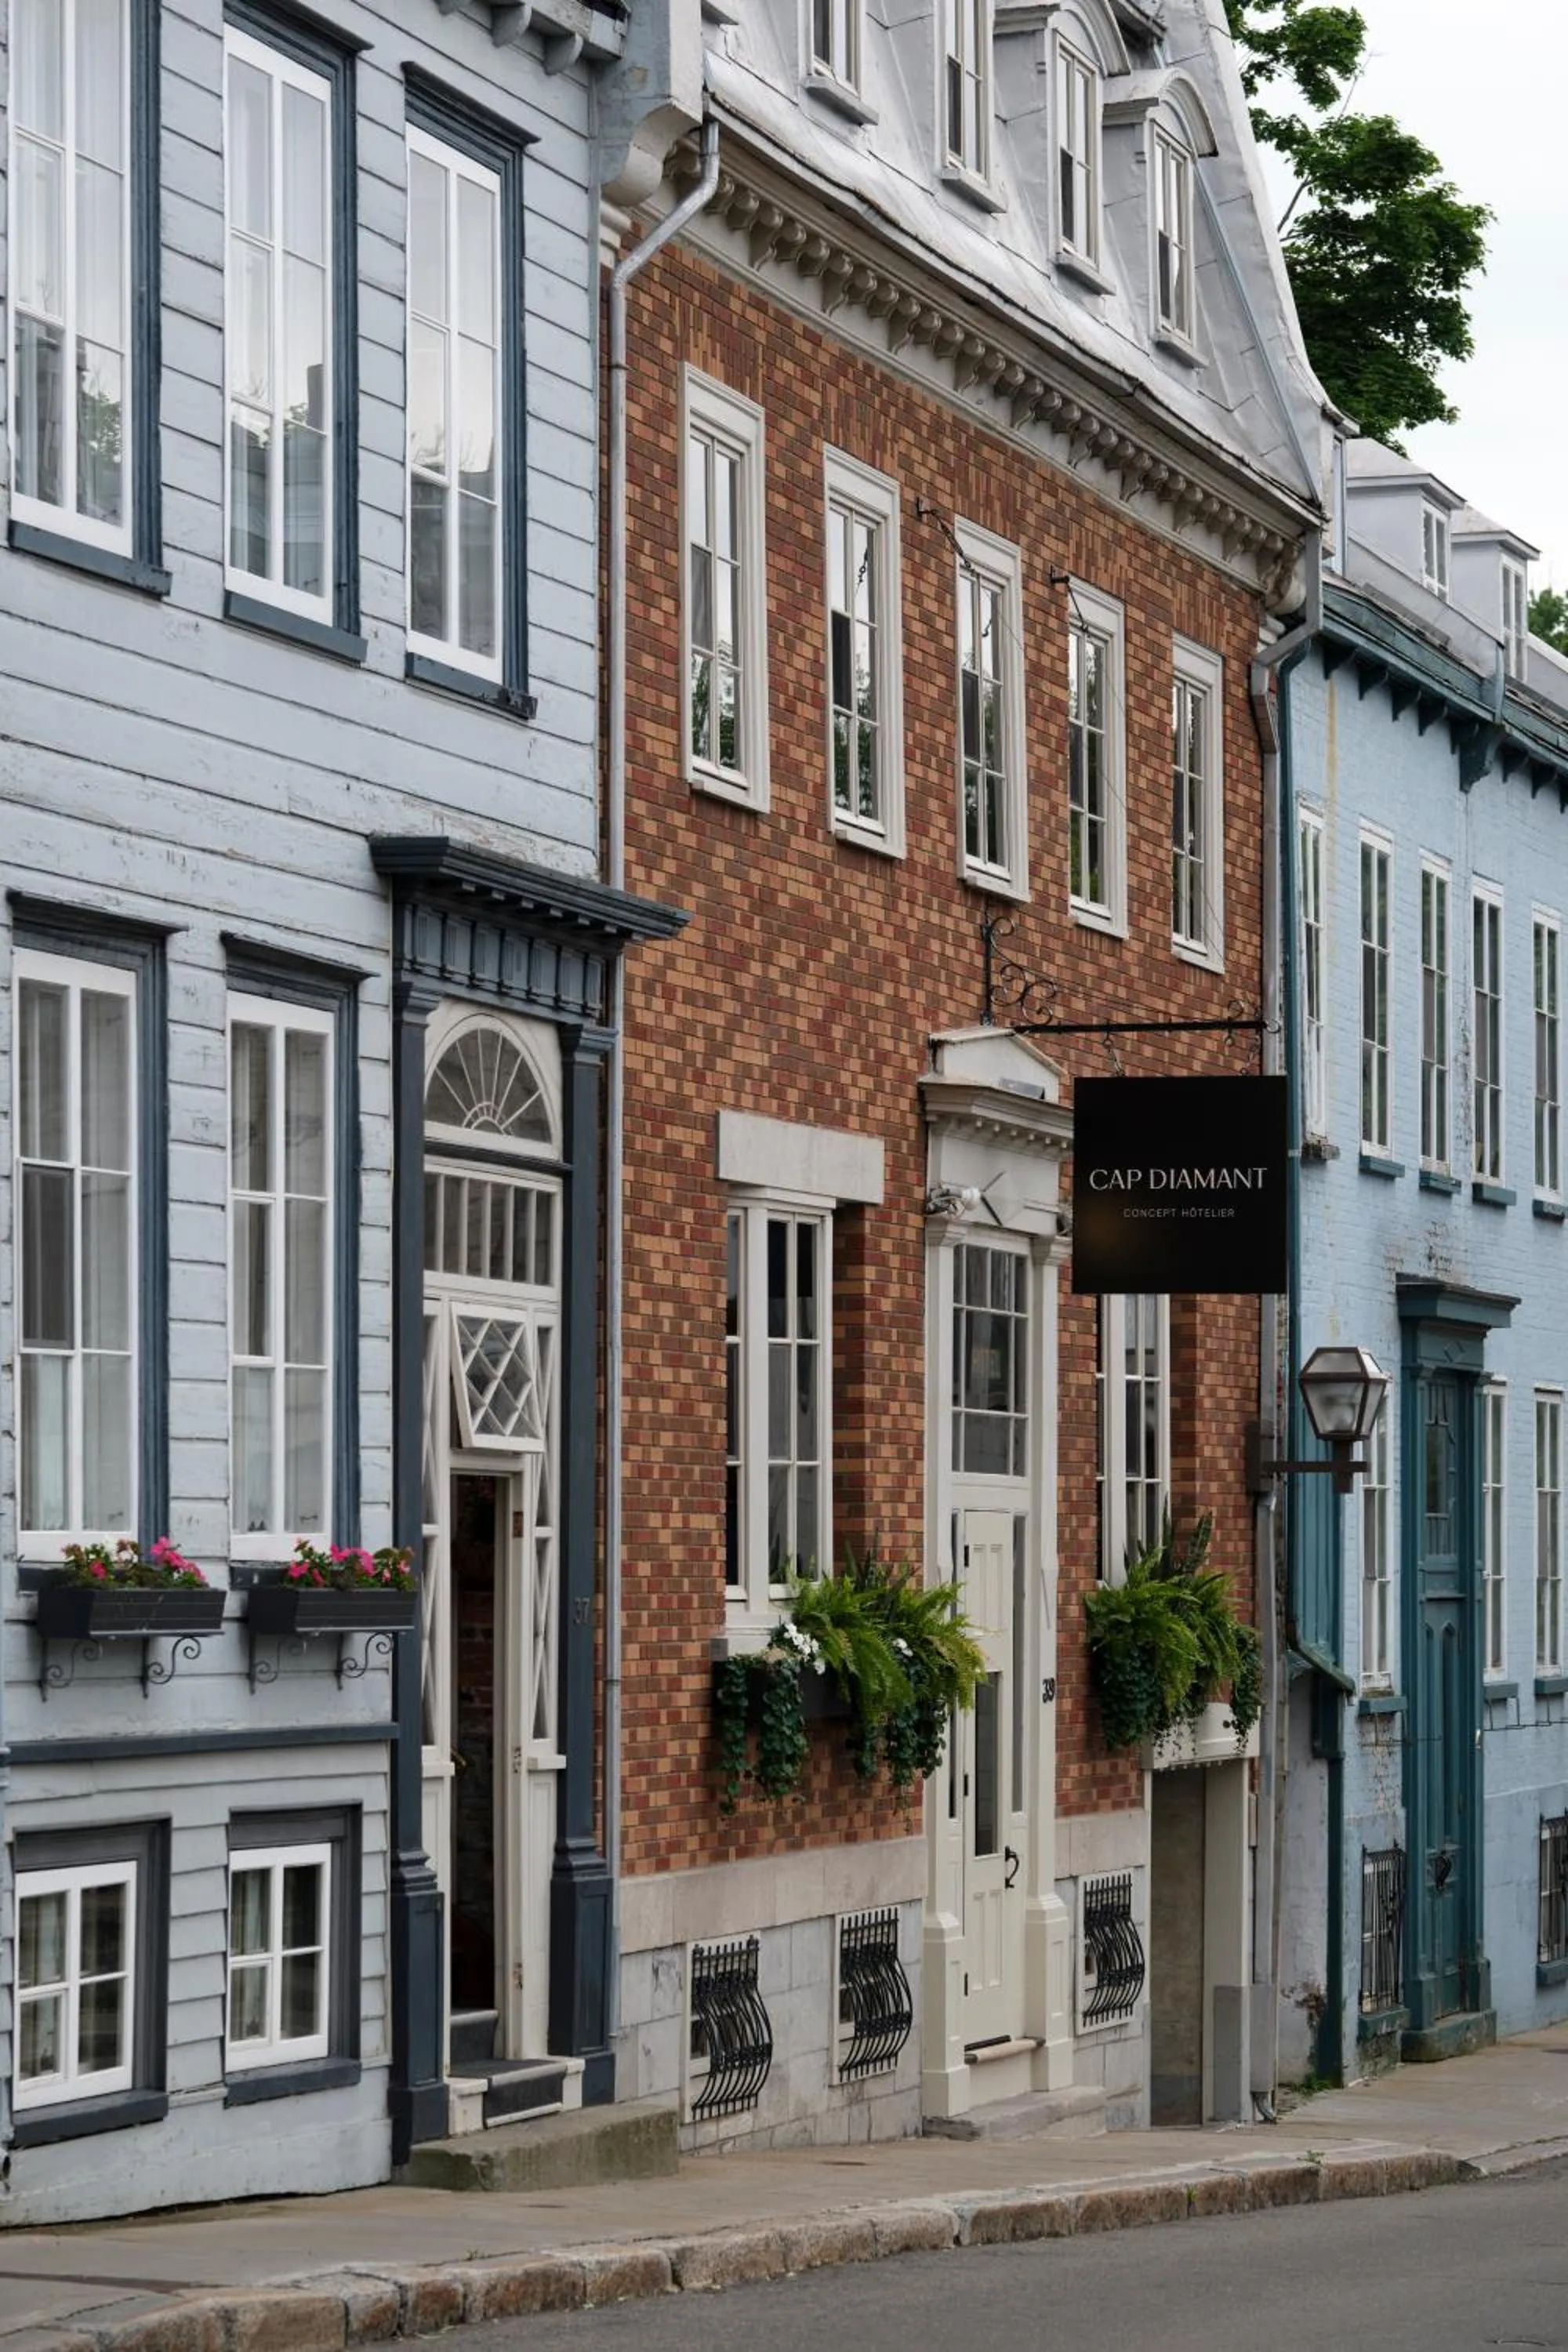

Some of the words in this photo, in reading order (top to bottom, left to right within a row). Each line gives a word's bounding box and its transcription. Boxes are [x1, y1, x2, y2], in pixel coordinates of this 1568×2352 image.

[1089, 1168, 1142, 1190] CAP
[1149, 1167, 1268, 1189] DIAMANT
[1123, 1208, 1176, 1218] CONCEPT
[1181, 1207, 1235, 1218] HÔTELIER
[574, 1596, 590, 1624] 37
[1042, 1677, 1055, 1704] 39
